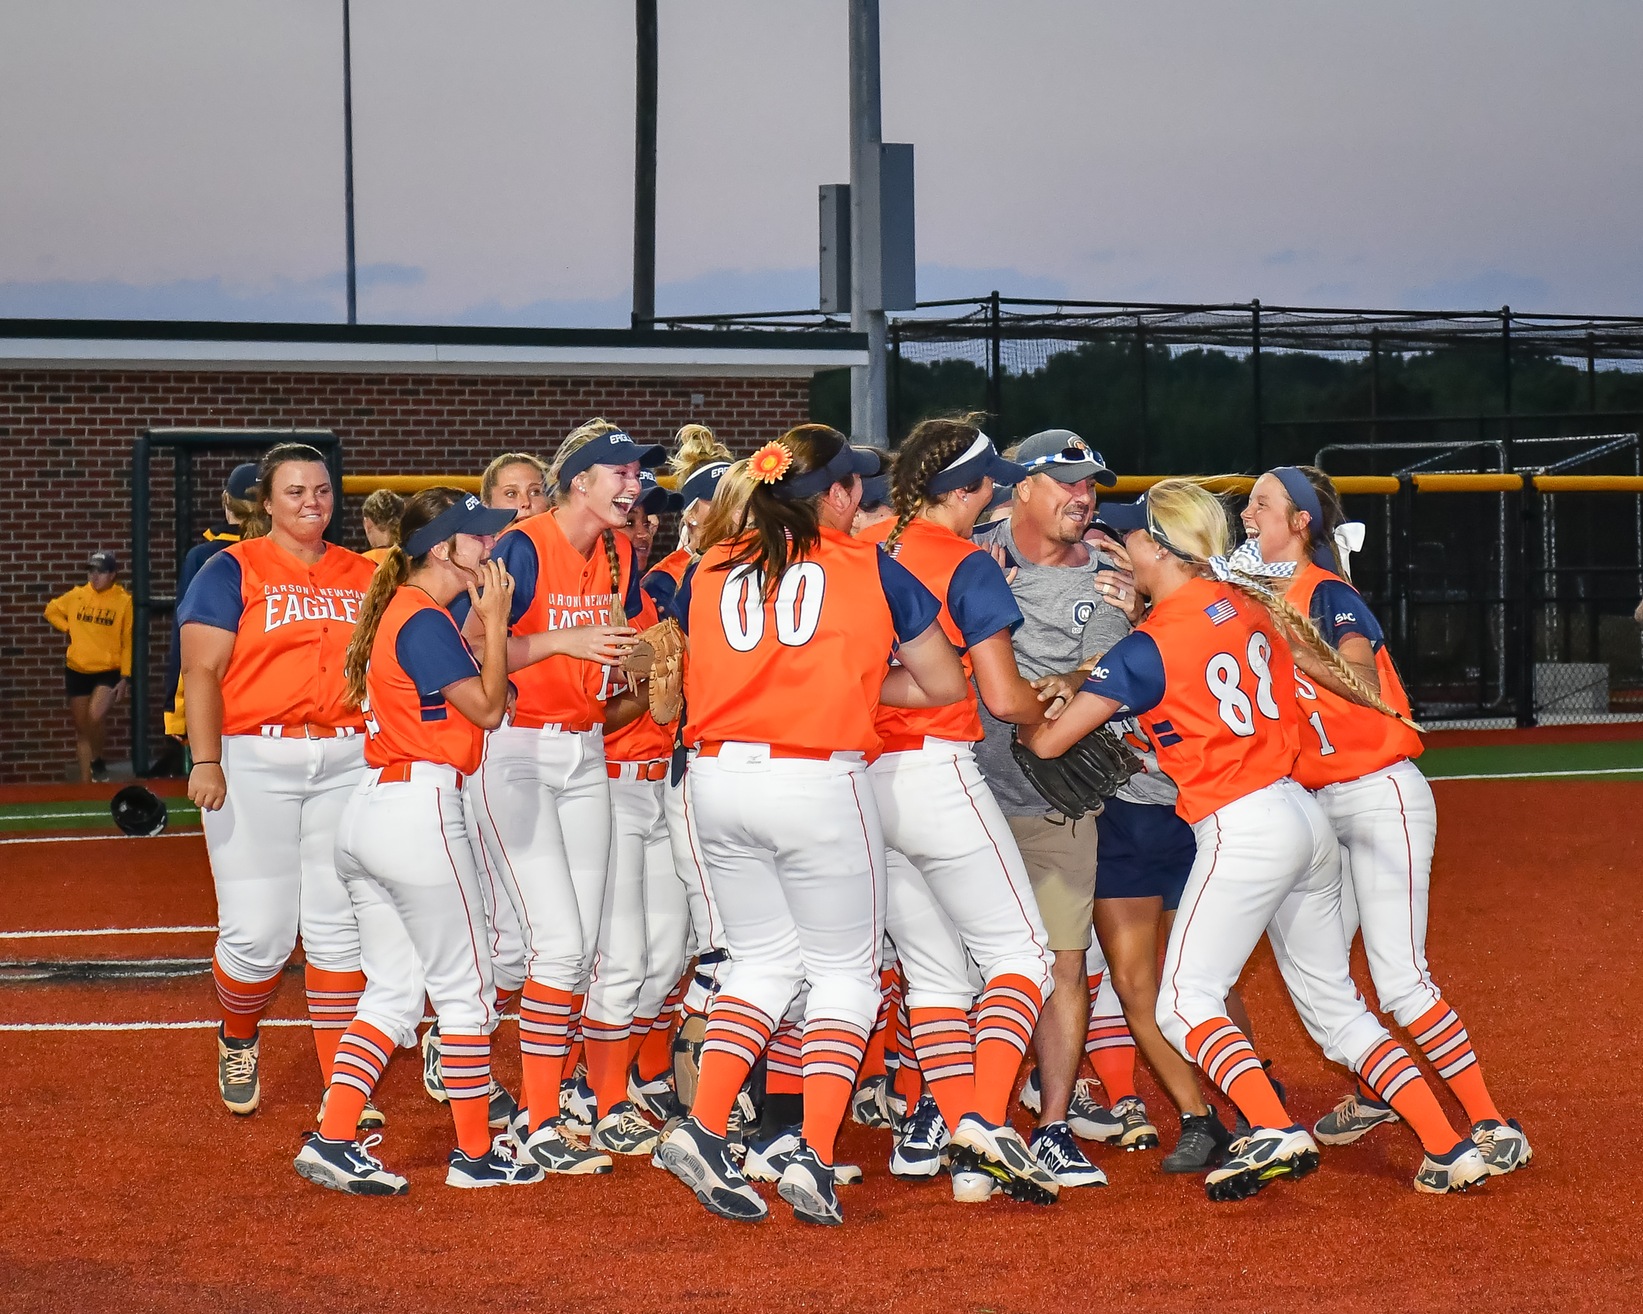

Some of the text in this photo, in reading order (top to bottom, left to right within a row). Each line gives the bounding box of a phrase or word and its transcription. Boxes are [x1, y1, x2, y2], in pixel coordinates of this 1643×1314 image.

[264, 584, 308, 595] CARSON
[720, 561, 825, 652] 00
[264, 593, 363, 633] EAGLE
[1334, 612, 1356, 623] SAC
[1205, 630, 1280, 736] 88
[1308, 711, 1336, 757] 1
